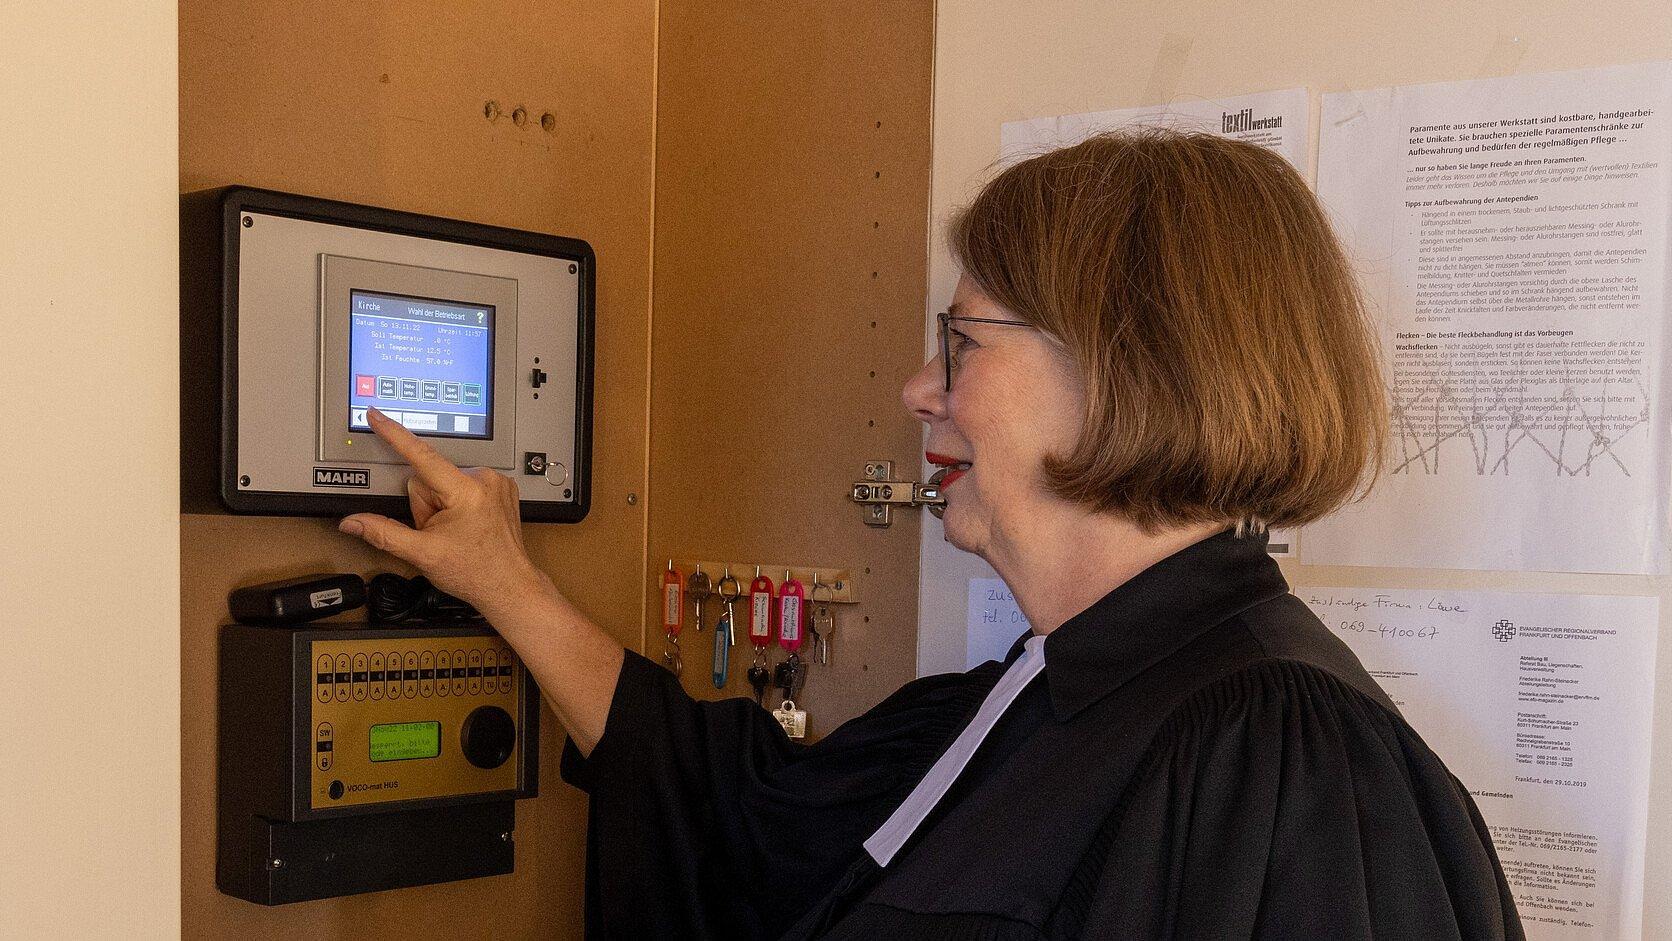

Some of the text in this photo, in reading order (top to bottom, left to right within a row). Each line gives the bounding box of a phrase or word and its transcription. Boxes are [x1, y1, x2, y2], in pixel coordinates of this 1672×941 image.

[1410, 123, 1450, 133] Paramente
[1500, 117, 1537, 127] Werkstatt
[1540, 115, 1556, 124] sind
[1558, 113, 1597, 123] kostbare,
[1598, 109, 1654, 120] handgearbei-
[1410, 136, 1423, 144] tete
[1426, 134, 1457, 143] Unikate.
[1458, 133, 1469, 141] Sie
[1471, 131, 1507, 140] brauchen
[1509, 128, 1542, 139] spezielle
[1545, 122, 1628, 135] Paramentenschränke
[1408, 146, 1462, 156] Aufbewahrung
[1464, 144, 1479, 153] und
[1481, 142, 1516, 152] bedürfen
[1518, 141, 1530, 149] der
[1533, 138, 1588, 149] regelmäßigen
[1590, 136, 1616, 145] Pflege
[1490, 160, 1512, 168] Freude
[1543, 156, 1585, 164] Paramenten.
[1405, 200, 1421, 208] Tipps
[1434, 197, 1481, 206] Aufbewahrung
[1496, 194, 1538, 203] Antependien
[358, 300, 380, 310] Kirche
[408, 307, 424, 315] Wahl
[435, 310, 466, 320] Betriebsart
[389, 332, 423, 342] Temperatur
[1457, 330, 1512, 338] Fleckbehandlung
[1537, 329, 1574, 337] Vorbeugen
[389, 344, 422, 353] Temperatur
[396, 355, 420, 363] Feuchte
[317, 472, 366, 484] MAHR
[348, 781, 398, 792] VOCO-mat HUS
[1515, 776, 1541, 785] Frankfurt,
[1554, 779, 1586, 787] 29.10.2019
[1563, 831, 1598, 840] informieren.
[1557, 837, 1597, 846] Evangelischen
[1539, 842, 1582, 852] 069/2165-2177
[1523, 861, 1551, 870] auftreten,
[1552, 863, 1573, 871] können
[1556, 871, 1579, 879] bekannt
[1510, 874, 1536, 882] erfragen.
[1562, 878, 1596, 888] Änderungen
[1523, 880, 1558, 890] Information.
[1525, 901, 1553, 909] Offenbach
